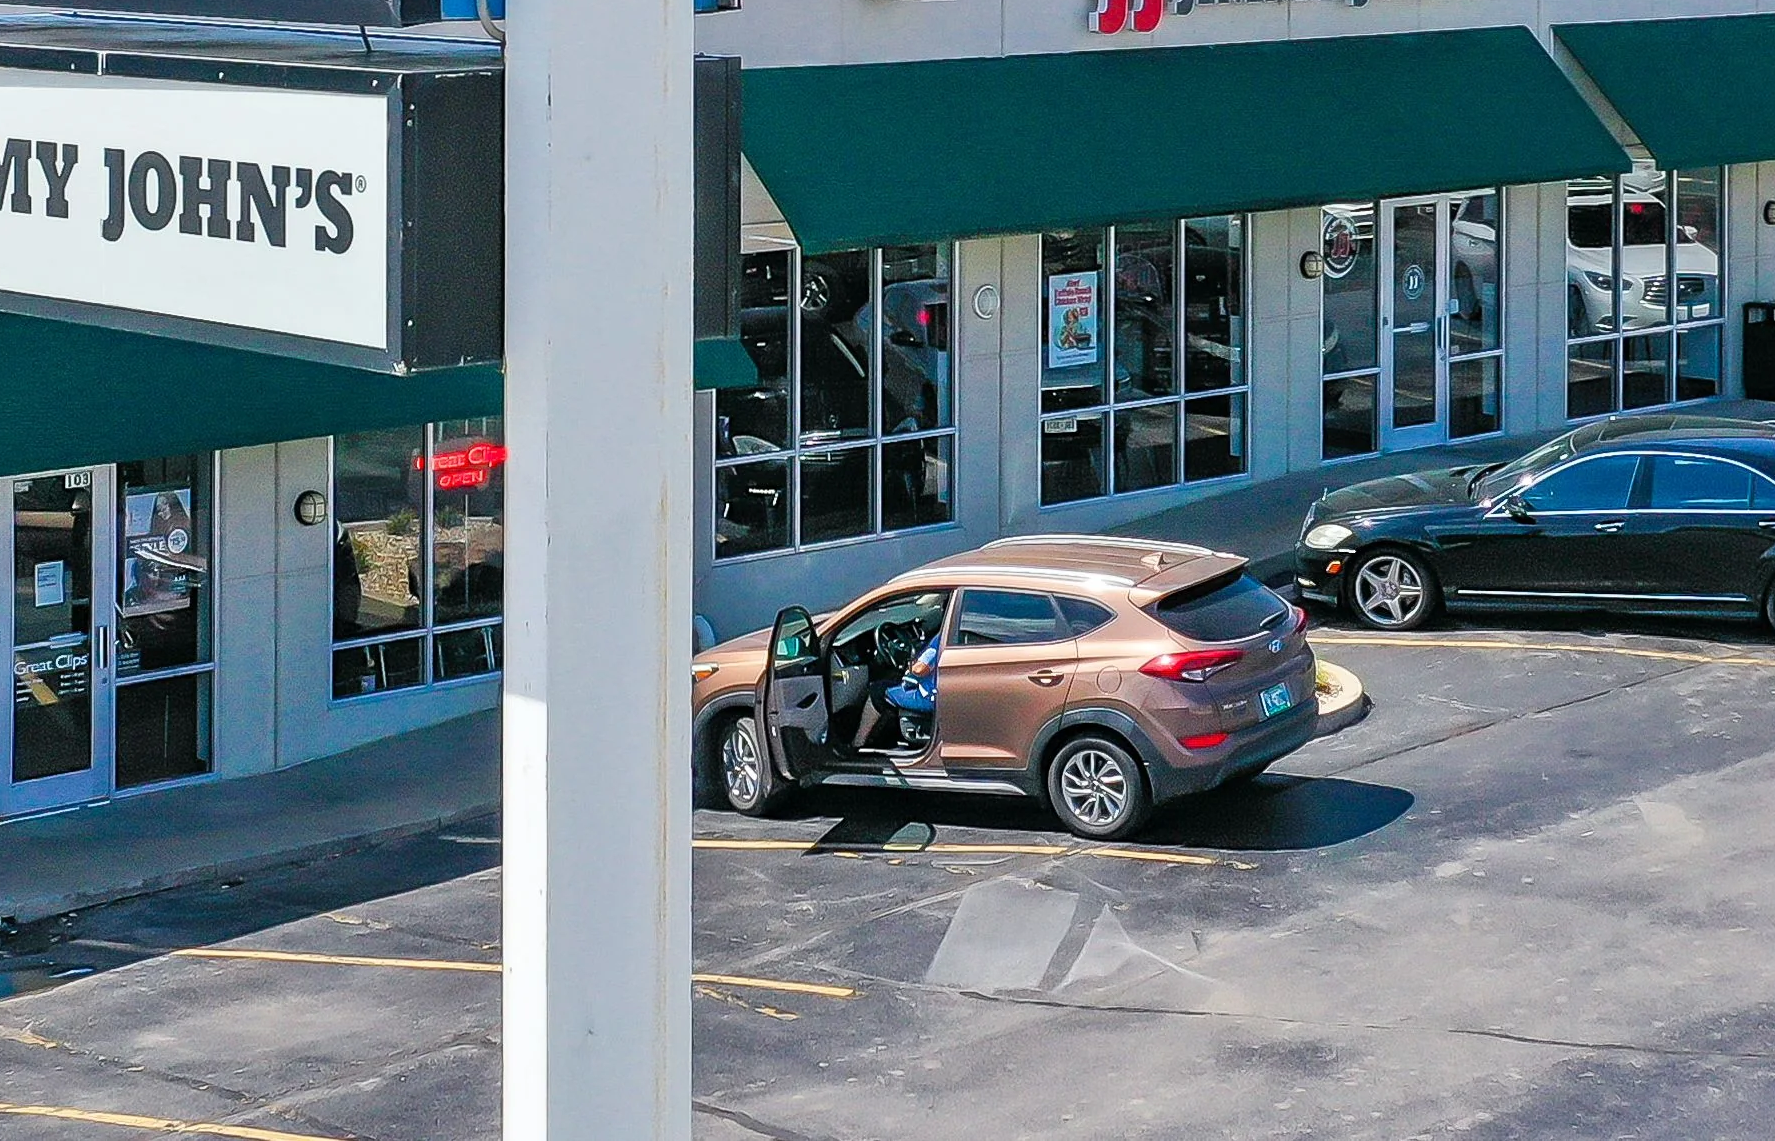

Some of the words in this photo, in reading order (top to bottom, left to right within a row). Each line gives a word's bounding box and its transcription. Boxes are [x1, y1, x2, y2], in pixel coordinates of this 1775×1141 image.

[101, 148, 354, 255] JOHN'S
[68, 473, 89, 488] 103
[439, 469, 484, 487] OPEN
[13, 660, 53, 675] Great
[55, 653, 88, 670] Clips
